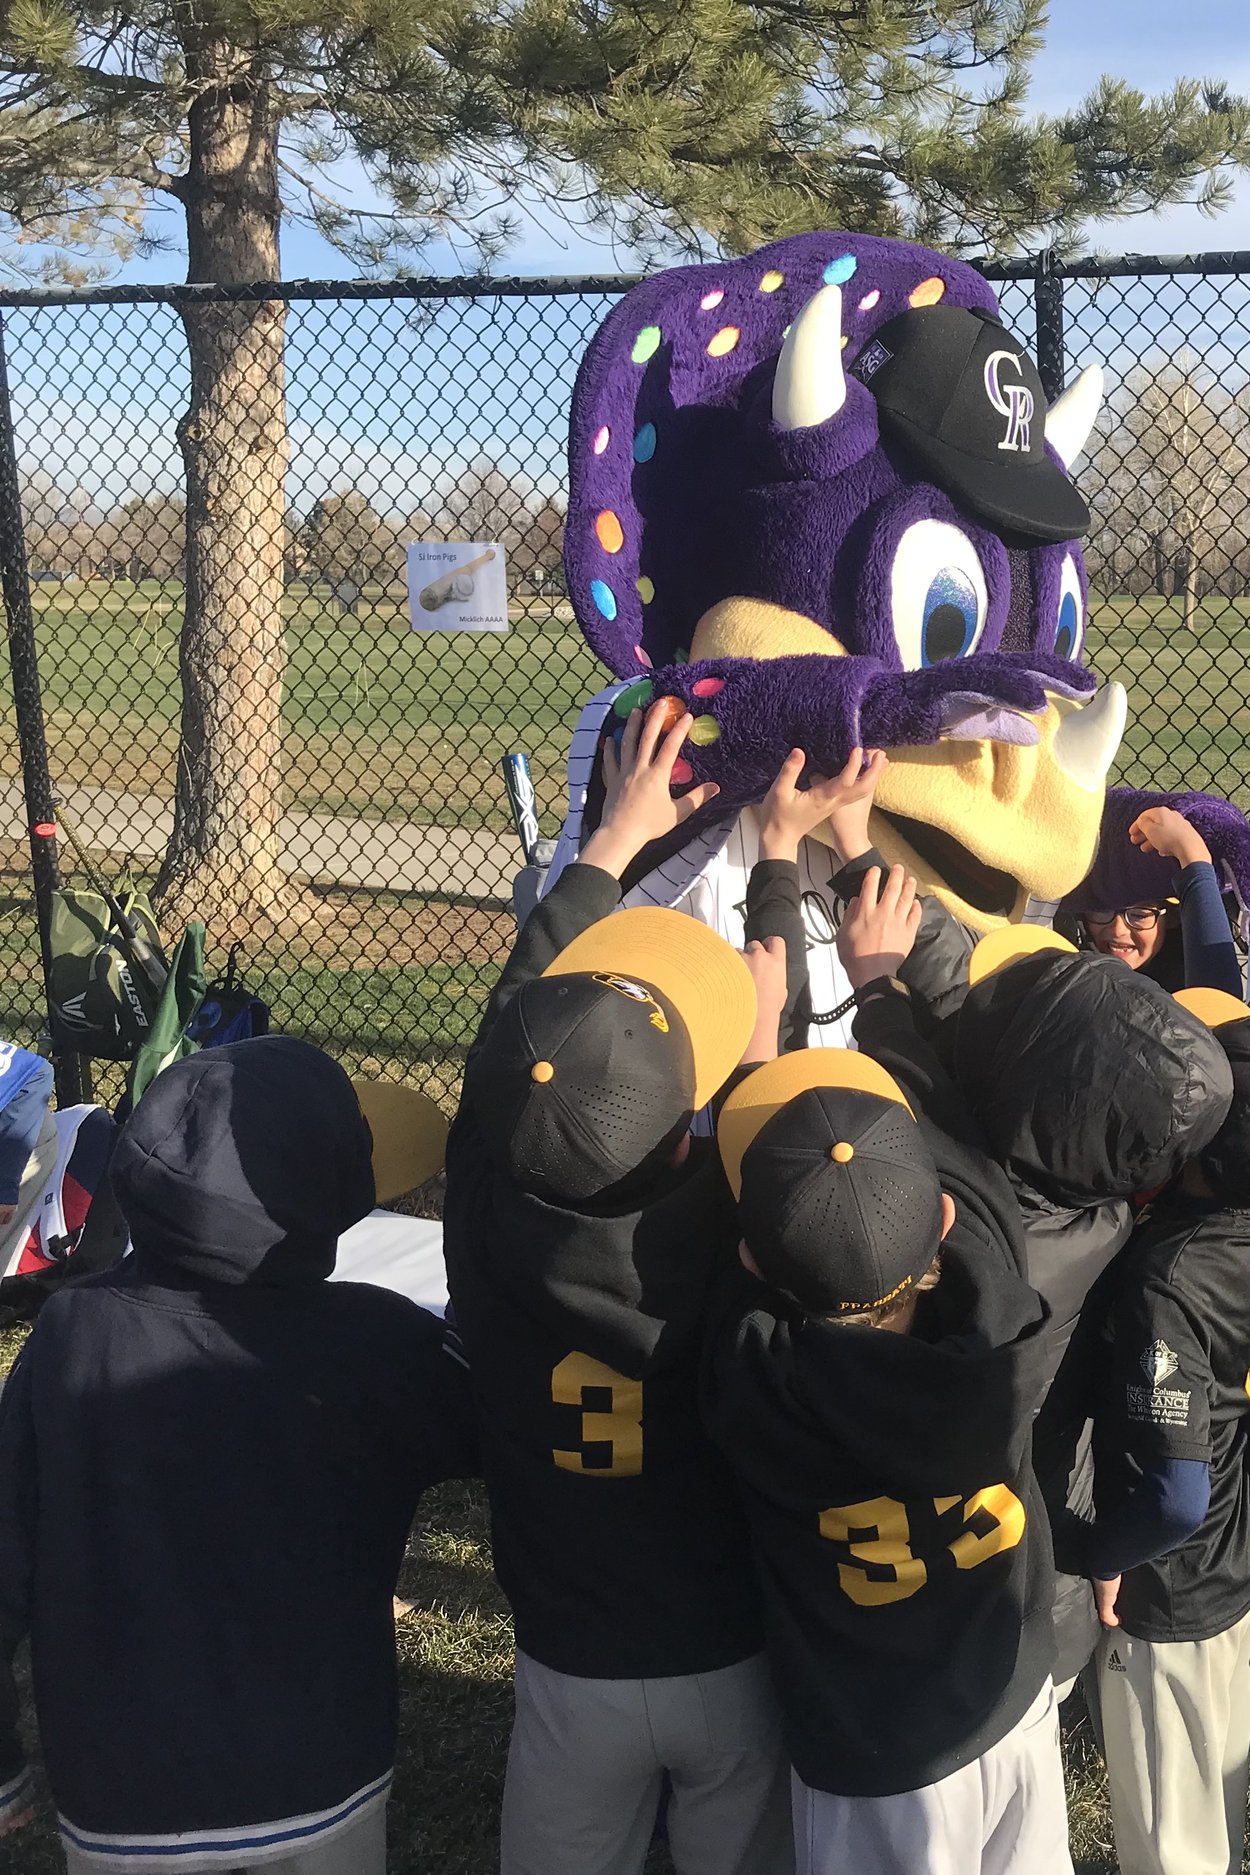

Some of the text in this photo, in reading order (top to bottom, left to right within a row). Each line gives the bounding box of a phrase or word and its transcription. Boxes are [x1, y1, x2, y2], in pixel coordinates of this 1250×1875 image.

[427, 553, 441, 561] Iron
[442, 553, 457, 563] Pigs
[116, 959, 149, 1027] EASTON
[1153, 1387, 1192, 1398] Columbus
[551, 1350, 643, 1478] 3
[1161, 1408, 1188, 1419] Agency
